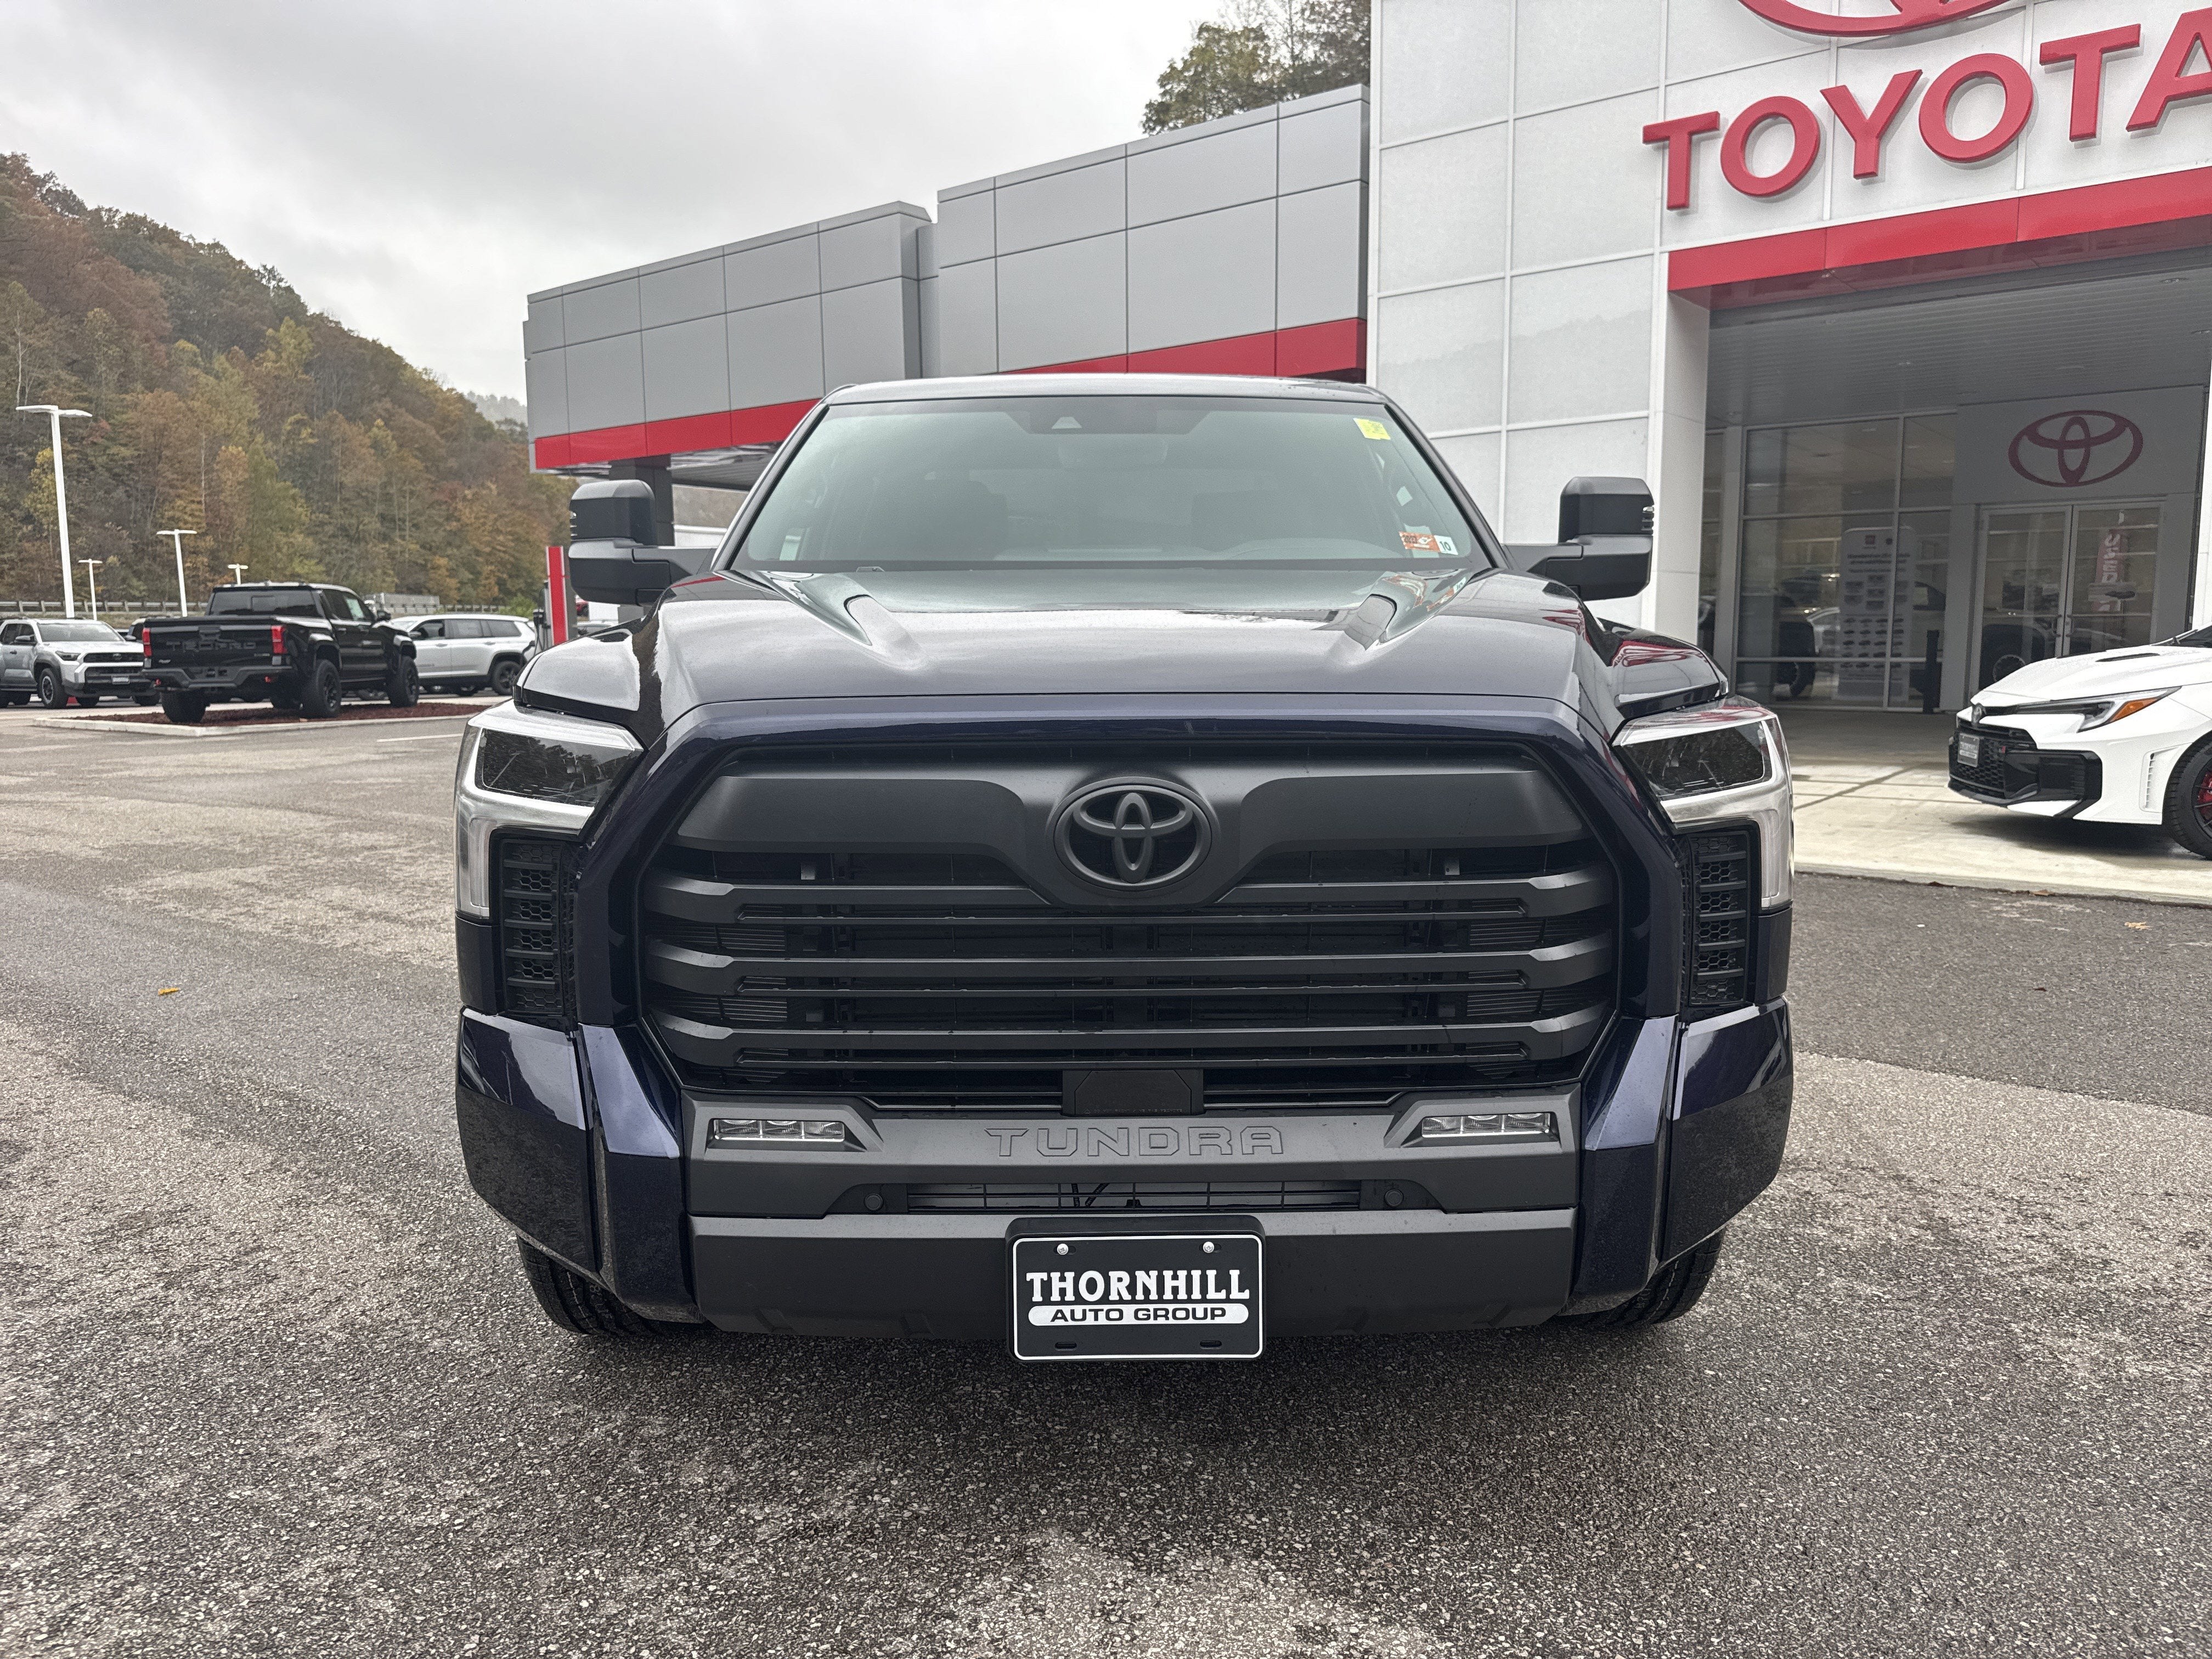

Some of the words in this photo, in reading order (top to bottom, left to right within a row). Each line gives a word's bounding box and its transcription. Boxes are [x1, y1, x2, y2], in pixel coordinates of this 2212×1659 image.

[1643, 7, 2212, 211] TOYOTA
[1440, 541, 1452, 551] 10
[984, 1126, 1284, 1157] TUNDRA
[1026, 1269, 1250, 1302] THORNHILL
[1050, 1308, 1124, 1322] AUTO
[1133, 1307, 1227, 1321] GROUP
